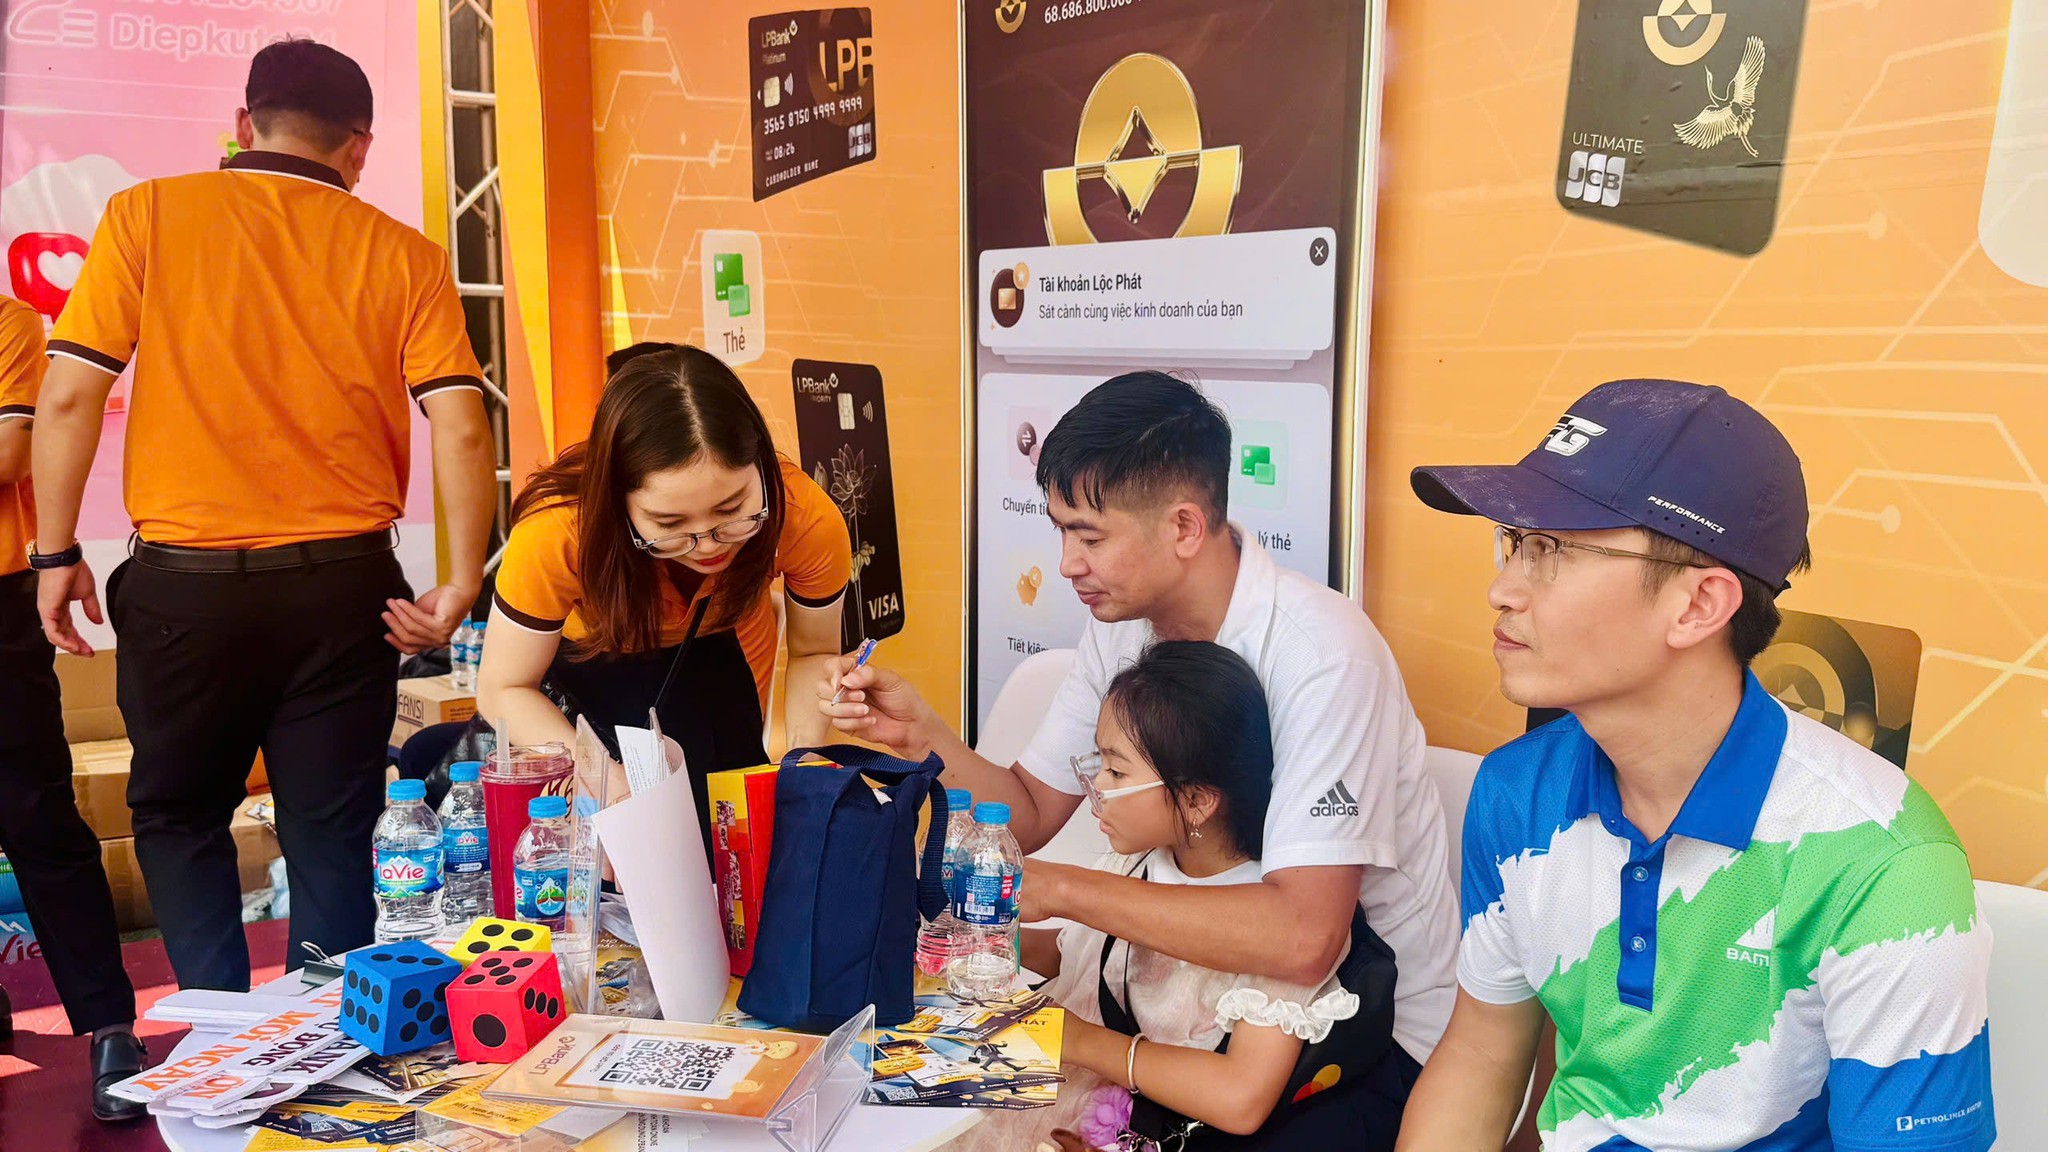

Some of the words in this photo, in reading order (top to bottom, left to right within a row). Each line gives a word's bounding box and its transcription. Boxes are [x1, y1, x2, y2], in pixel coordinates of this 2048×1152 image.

[762, 28, 791, 49] LPBank
[764, 115, 785, 135] 3565
[788, 108, 810, 127] 8750
[813, 102, 836, 120] 4999
[839, 96, 863, 113] 9999
[774, 142, 796, 160] 08/26
[1573, 132, 1644, 154] ULTIMATE
[765, 165, 801, 188] CARDHOLDER
[1039, 277, 1054, 293] Tài
[1057, 274, 1090, 292] khoản
[1093, 275, 1113, 294] Lộc
[1116, 272, 1142, 290] Phát
[1039, 303, 1055, 319] Sát
[1111, 303, 1132, 321] việc
[1134, 302, 1156, 318] kinh
[1159, 301, 1194, 318] doanh
[1197, 299, 1218, 318] của
[1221, 301, 1243, 320] bạn
[723, 326, 746, 354] Thẻ
[796, 376, 831, 394] LPBank
[1003, 497, 1037, 516] Chuyển
[1647, 495, 1726, 534] PERFORMANCE
[1271, 532, 1291, 551] thẻ
[867, 592, 900, 620] VISA
[1008, 636, 1025, 654] Tiết
[1310, 803, 1359, 817] adidas
[379, 863, 425, 880] laVie
[281, 1035, 362, 1074] ANK
[529, 1043, 576, 1076] LPBank
